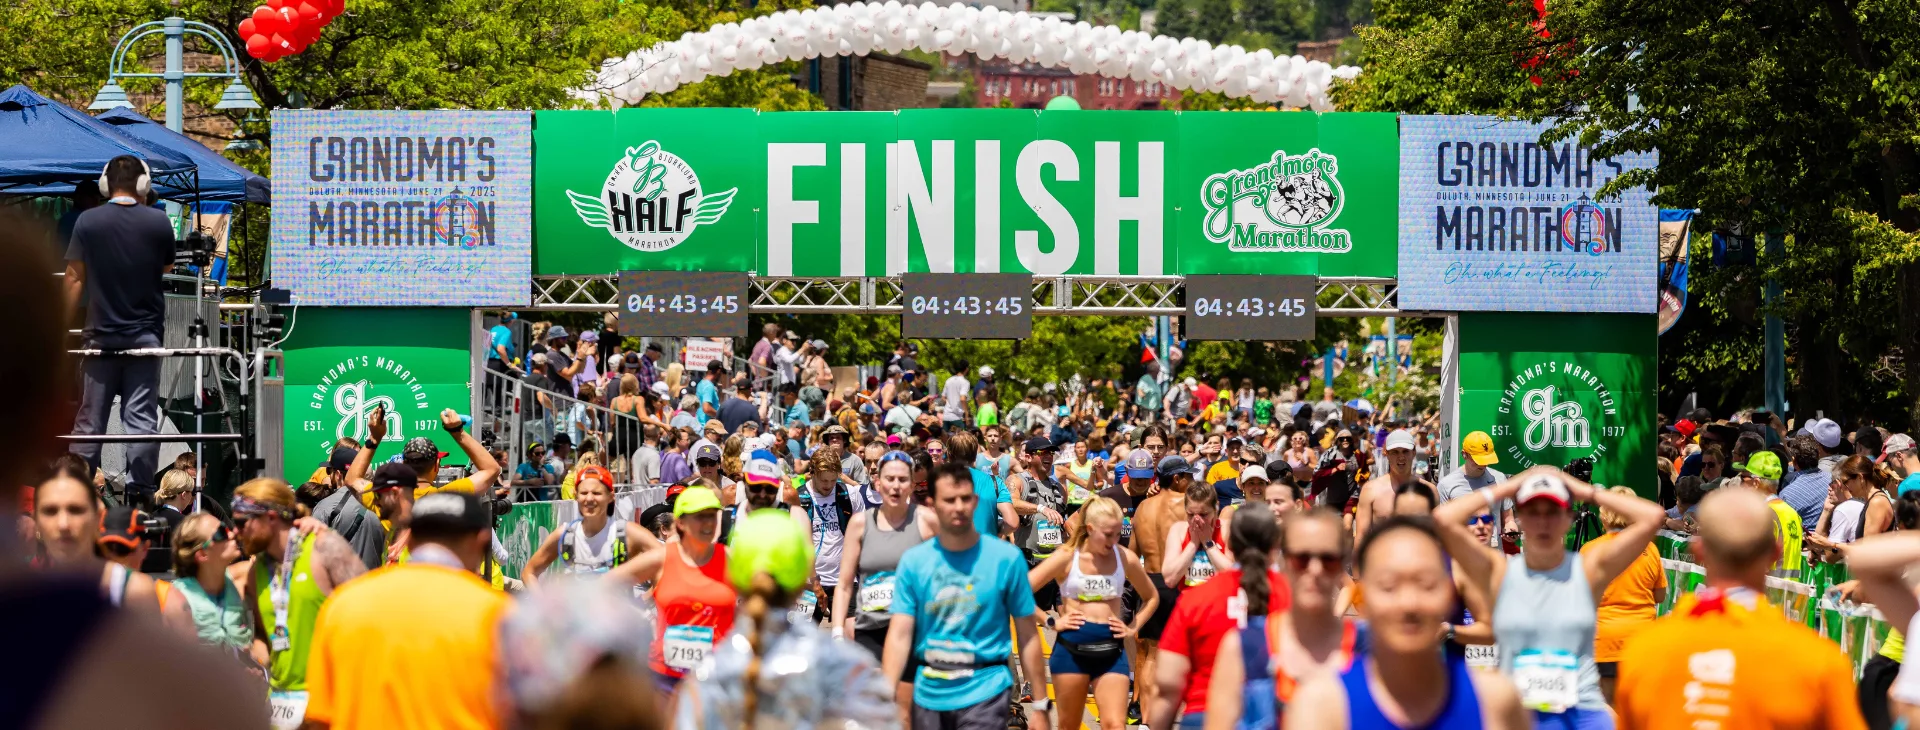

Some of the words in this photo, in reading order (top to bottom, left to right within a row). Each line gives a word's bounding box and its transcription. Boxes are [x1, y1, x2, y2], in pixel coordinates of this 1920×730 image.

[309, 136, 495, 182] GRANDMA'S
[1437, 141, 1622, 188] GRANDMAS
[309, 187, 344, 196] DULUTH,
[348, 187, 397, 196] MINNESOTA
[407, 187, 429, 196] JUNE
[433, 187, 442, 196] 21
[470, 186, 496, 197] 2025
[1436, 191, 1471, 201] DULUTH,
[1475, 192, 1525, 201] MINNESOTA
[1536, 193, 1557, 202] JUNE
[1560, 193, 1570, 202] 21
[608, 187, 698, 233] HALF
[767, 139, 1164, 276] FINISH
[309, 200, 496, 249] MARATHON
[1436, 205, 1623, 257] MARATHON
[627, 236, 676, 249] MARATHON
[1232, 223, 1348, 249] Marathon
[627, 294, 739, 313] 04:43:45
[911, 295, 1023, 315] 04:43:45
[1194, 297, 1306, 316] 04:43:45
[311, 355, 369, 409] GRANDMA'S
[376, 356, 429, 409] MARATHON
[1499, 361, 1556, 414] GRANDMA'S
[1563, 362, 1616, 415] MARATHON
[304, 421, 325, 431] EST.
[415, 420, 437, 430] 1977
[1491, 425, 1512, 435] EST.
[1602, 426, 1624, 436] 1977
[1187, 567, 1215, 577] 10136
[1085, 579, 1111, 589] 3248
[672, 646, 703, 660] 7193
[1465, 647, 1494, 659] 3344
